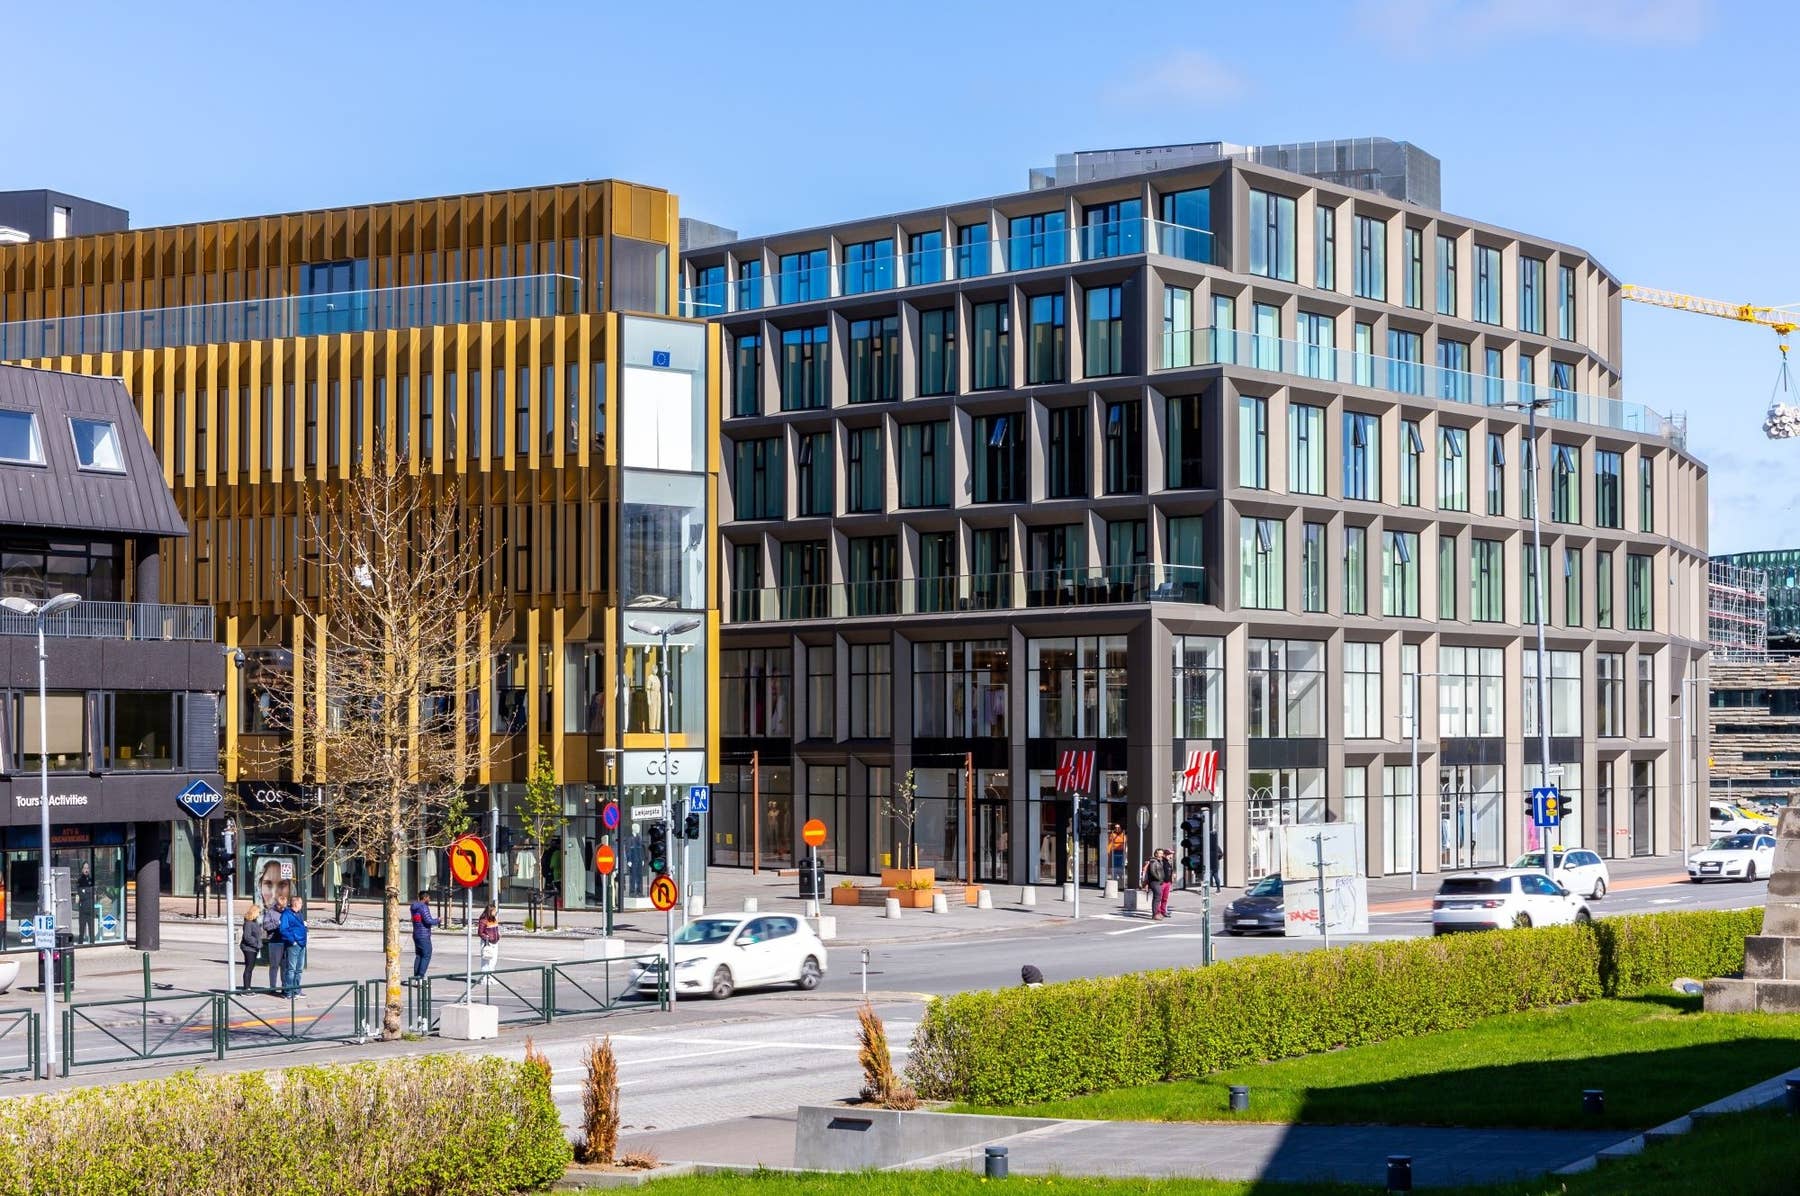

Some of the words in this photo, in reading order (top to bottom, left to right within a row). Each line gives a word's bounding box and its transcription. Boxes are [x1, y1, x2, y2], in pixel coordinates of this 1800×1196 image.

[646, 760, 680, 775] COS
[1056, 750, 1096, 793] H&M
[1183, 750, 1219, 795] H&M
[16, 796, 40, 807] Tours
[48, 794, 88, 806] Activities
[256, 789, 284, 803] COS
